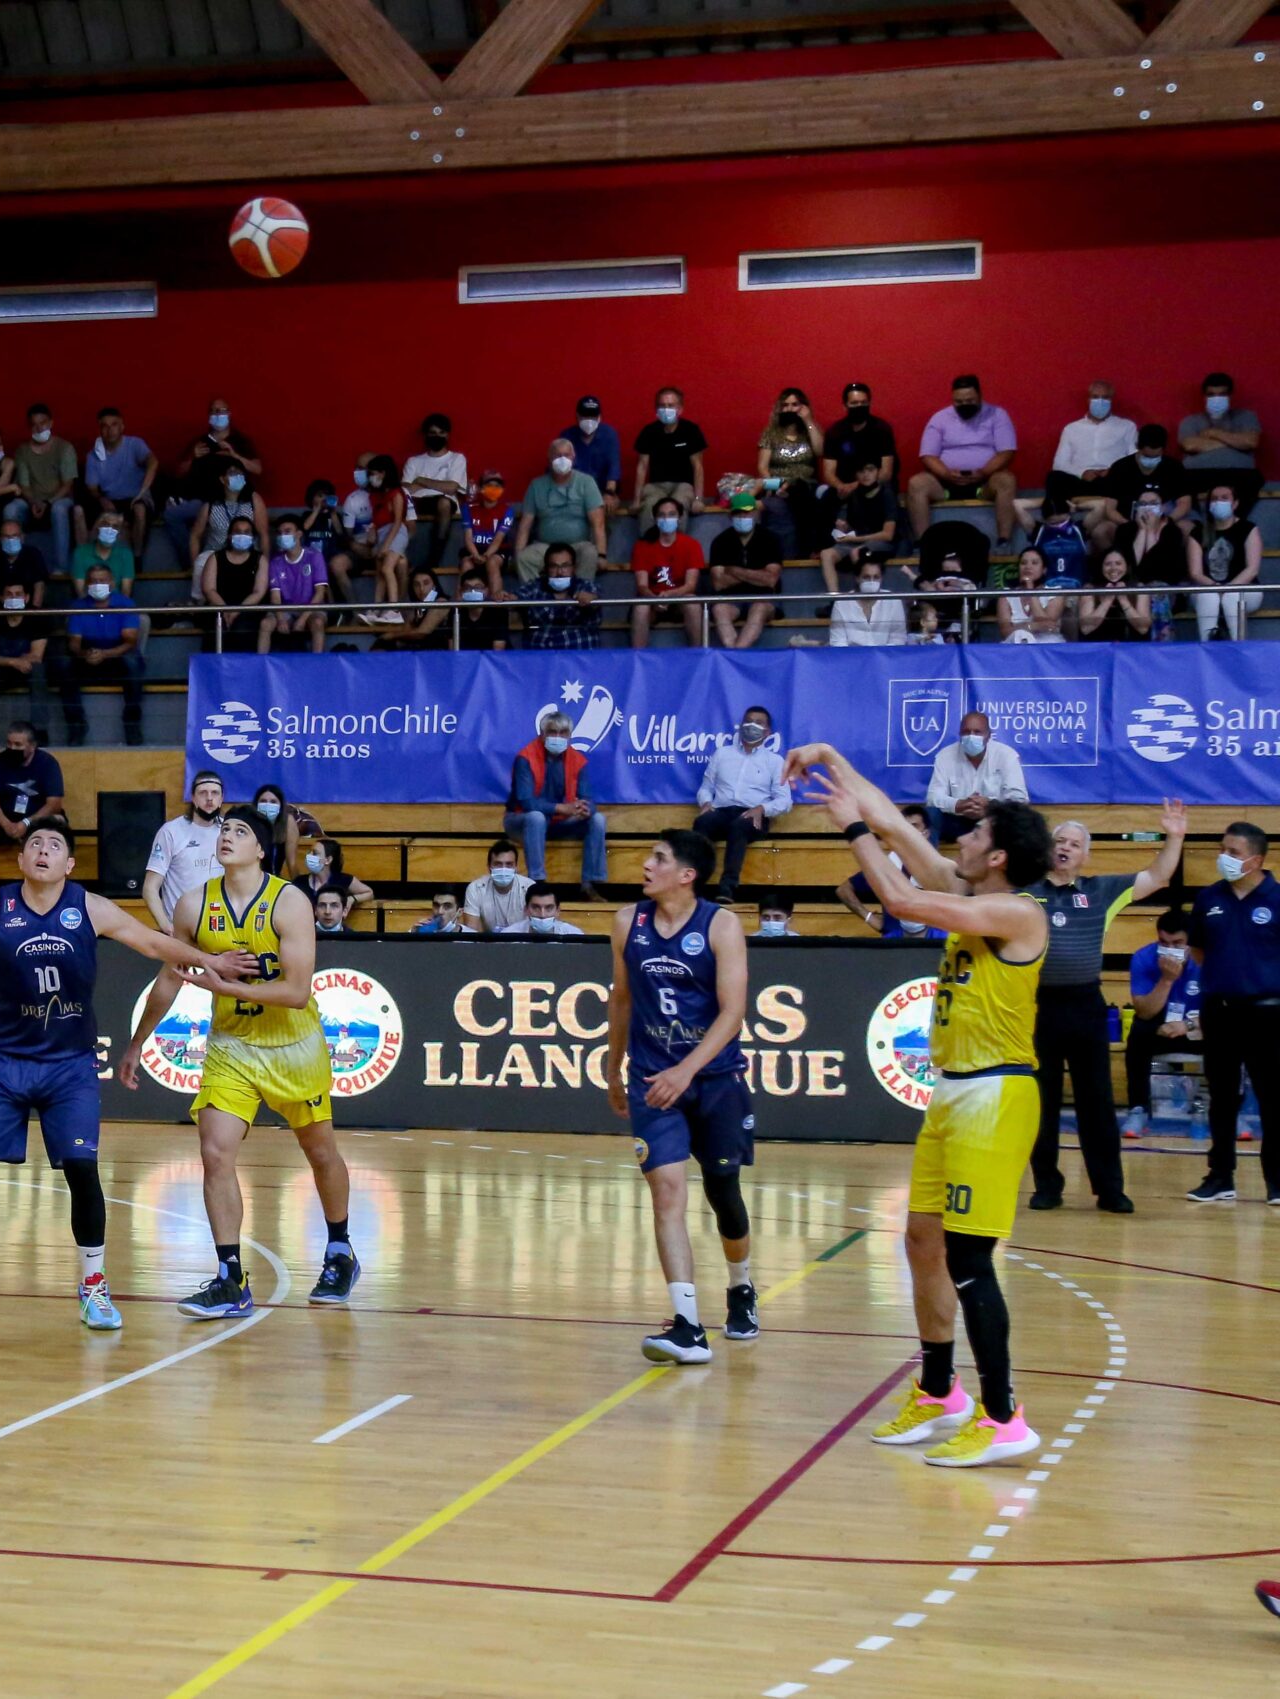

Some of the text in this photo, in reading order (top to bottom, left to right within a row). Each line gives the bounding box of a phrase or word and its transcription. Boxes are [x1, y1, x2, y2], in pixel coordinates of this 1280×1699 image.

[976, 701, 1087, 714] UNIVERSIDAD
[266, 704, 458, 735] SalmonChile
[909, 717, 940, 732] UA
[988, 716, 1086, 730] UTONOMA
[628, 714, 781, 753] Villarria
[1014, 732, 1085, 744] CHILE
[267, 739, 370, 758] 35 años
[1206, 735, 1241, 757] 35
[627, 755, 676, 764] ILUSTRE
[24, 943, 66, 953] CASINOS
[34, 966, 61, 993] 10
[644, 964, 685, 975] CASINOS
[313, 973, 373, 996] CINAS
[658, 987, 678, 1015] 6
[21, 994, 82, 1031] DREAMS
[945, 1182, 973, 1215] 30
